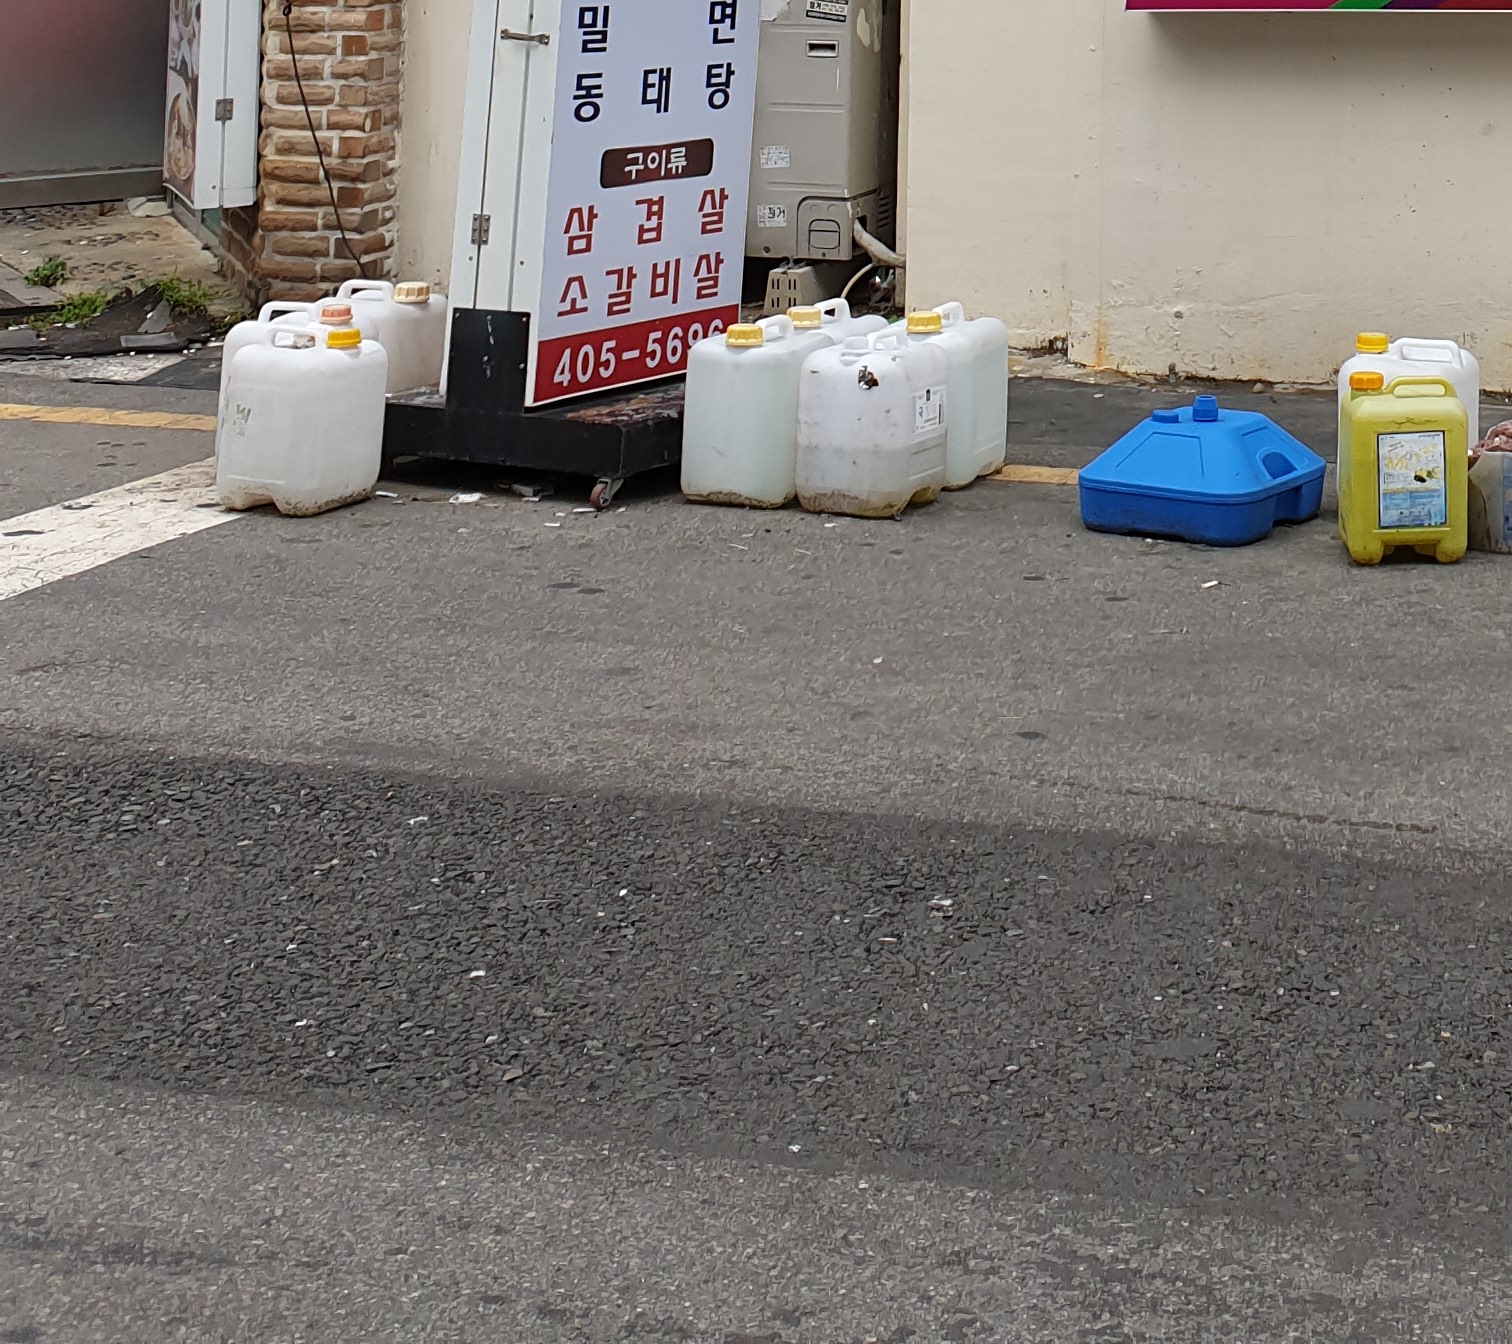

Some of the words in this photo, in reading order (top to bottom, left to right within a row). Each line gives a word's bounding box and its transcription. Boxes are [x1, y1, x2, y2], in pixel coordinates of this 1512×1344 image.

[573, 62, 735, 123] 동태탕
[624, 146, 688, 180] 구이류
[563, 187, 729, 257] 삼겹살
[556, 251, 725, 319] 소갈비살
